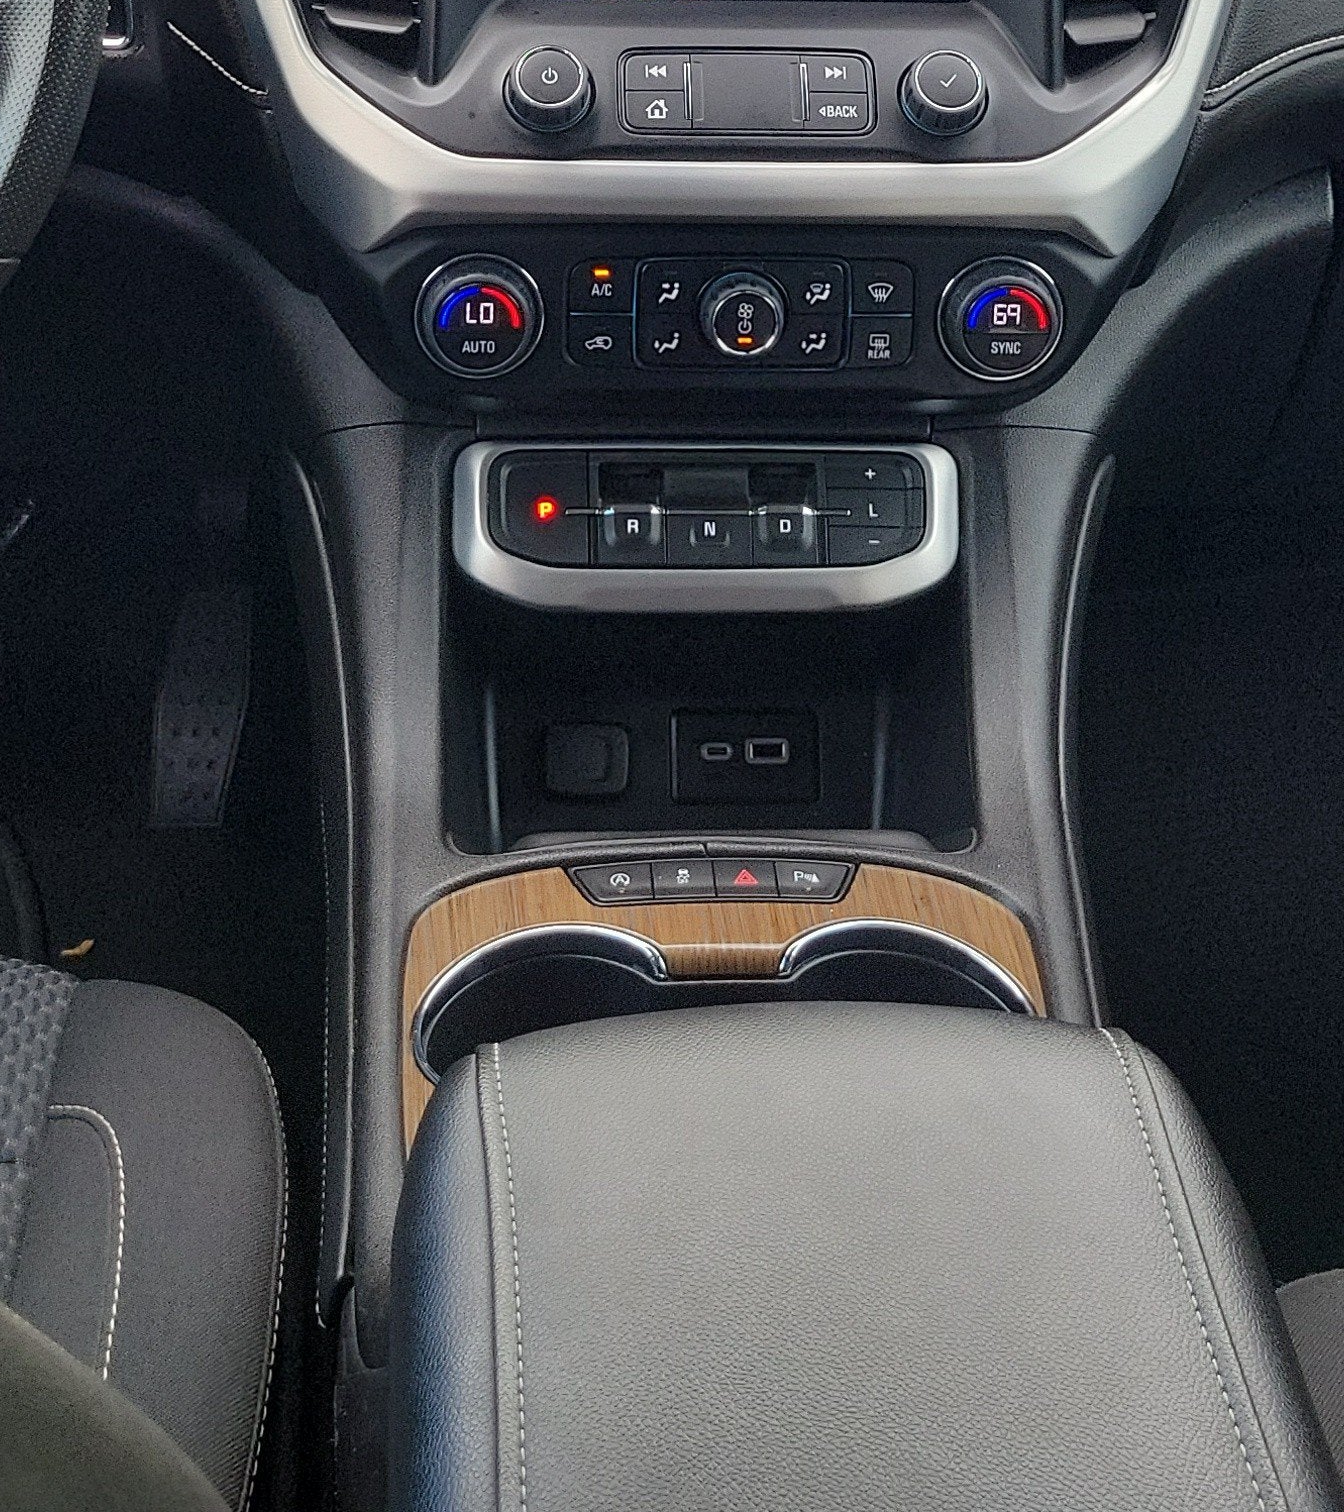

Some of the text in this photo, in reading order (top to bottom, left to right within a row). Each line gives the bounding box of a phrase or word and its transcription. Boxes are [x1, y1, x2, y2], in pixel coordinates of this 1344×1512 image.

[827, 105, 858, 118] BACK
[591, 284, 612, 297] A/C
[465, 302, 494, 324] LO
[993, 303, 1021, 325] 69
[461, 340, 496, 354] AUTO
[868, 349, 890, 359] REAR
[990, 342, 1021, 355] SYNC
[538, 501, 554, 519] P
[868, 504, 879, 518] L
[627, 518, 640, 535] R
[704, 521, 716, 537] N
[779, 519, 792, 534] D
